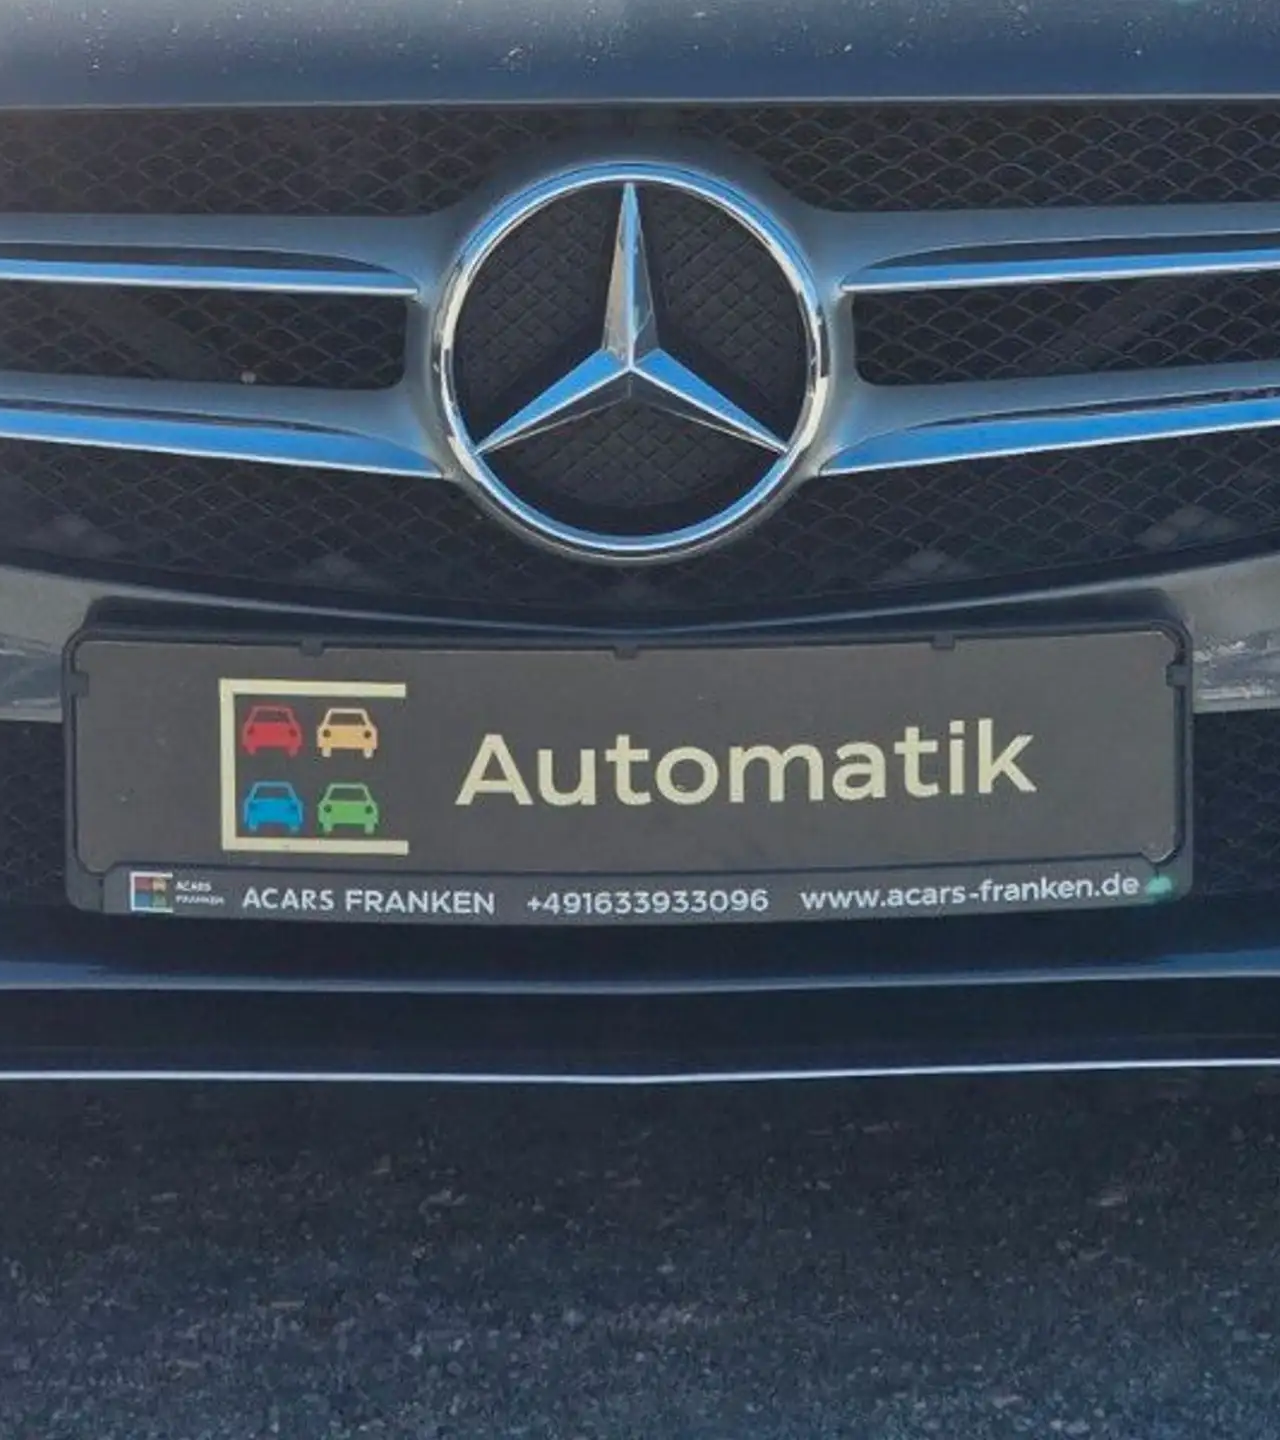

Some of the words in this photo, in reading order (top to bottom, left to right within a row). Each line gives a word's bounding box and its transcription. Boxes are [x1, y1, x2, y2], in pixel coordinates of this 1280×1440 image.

[454, 718, 1037, 807] Automatik
[242, 886, 335, 911] ACARS
[345, 888, 496, 914] FRANKEN
[526, 888, 769, 915] +491633933096
[799, 872, 1140, 911] www.acars-franken.de
